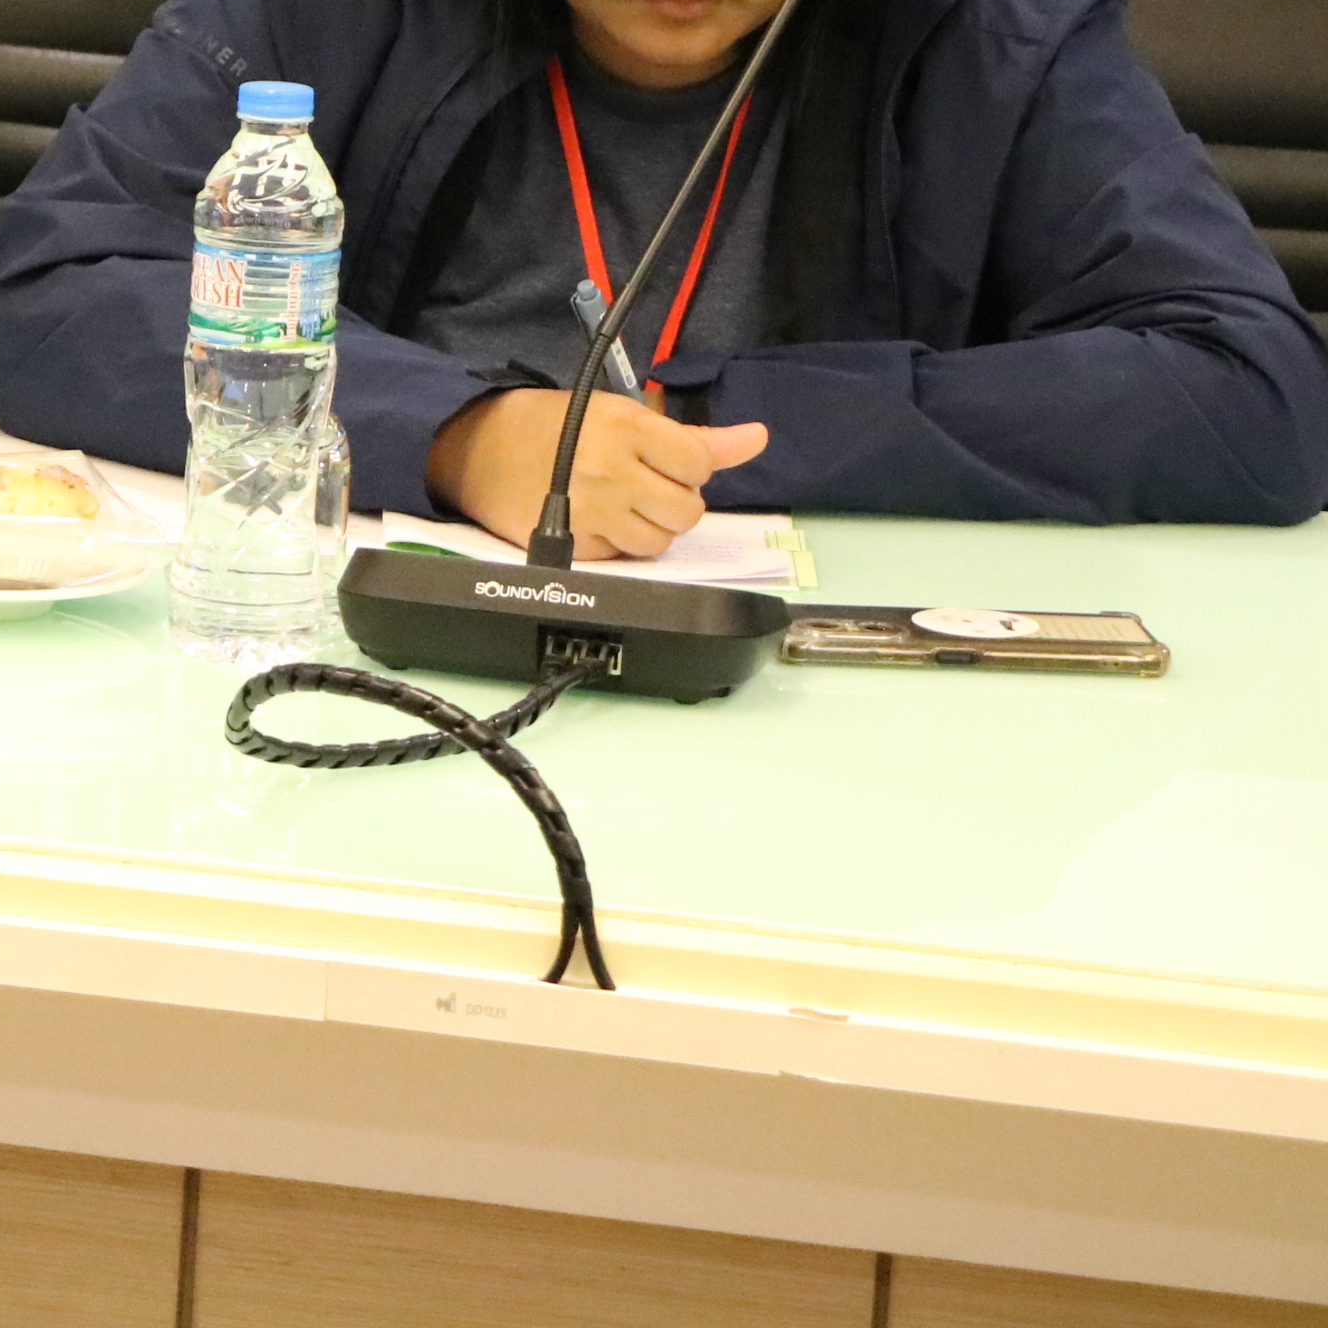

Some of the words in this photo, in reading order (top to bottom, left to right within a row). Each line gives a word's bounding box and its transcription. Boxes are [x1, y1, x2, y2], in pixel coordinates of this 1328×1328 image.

[193, 252, 246, 285] CEAN
[192, 275, 244, 308] RESH
[475, 580, 595, 608] SOUNDVISION
